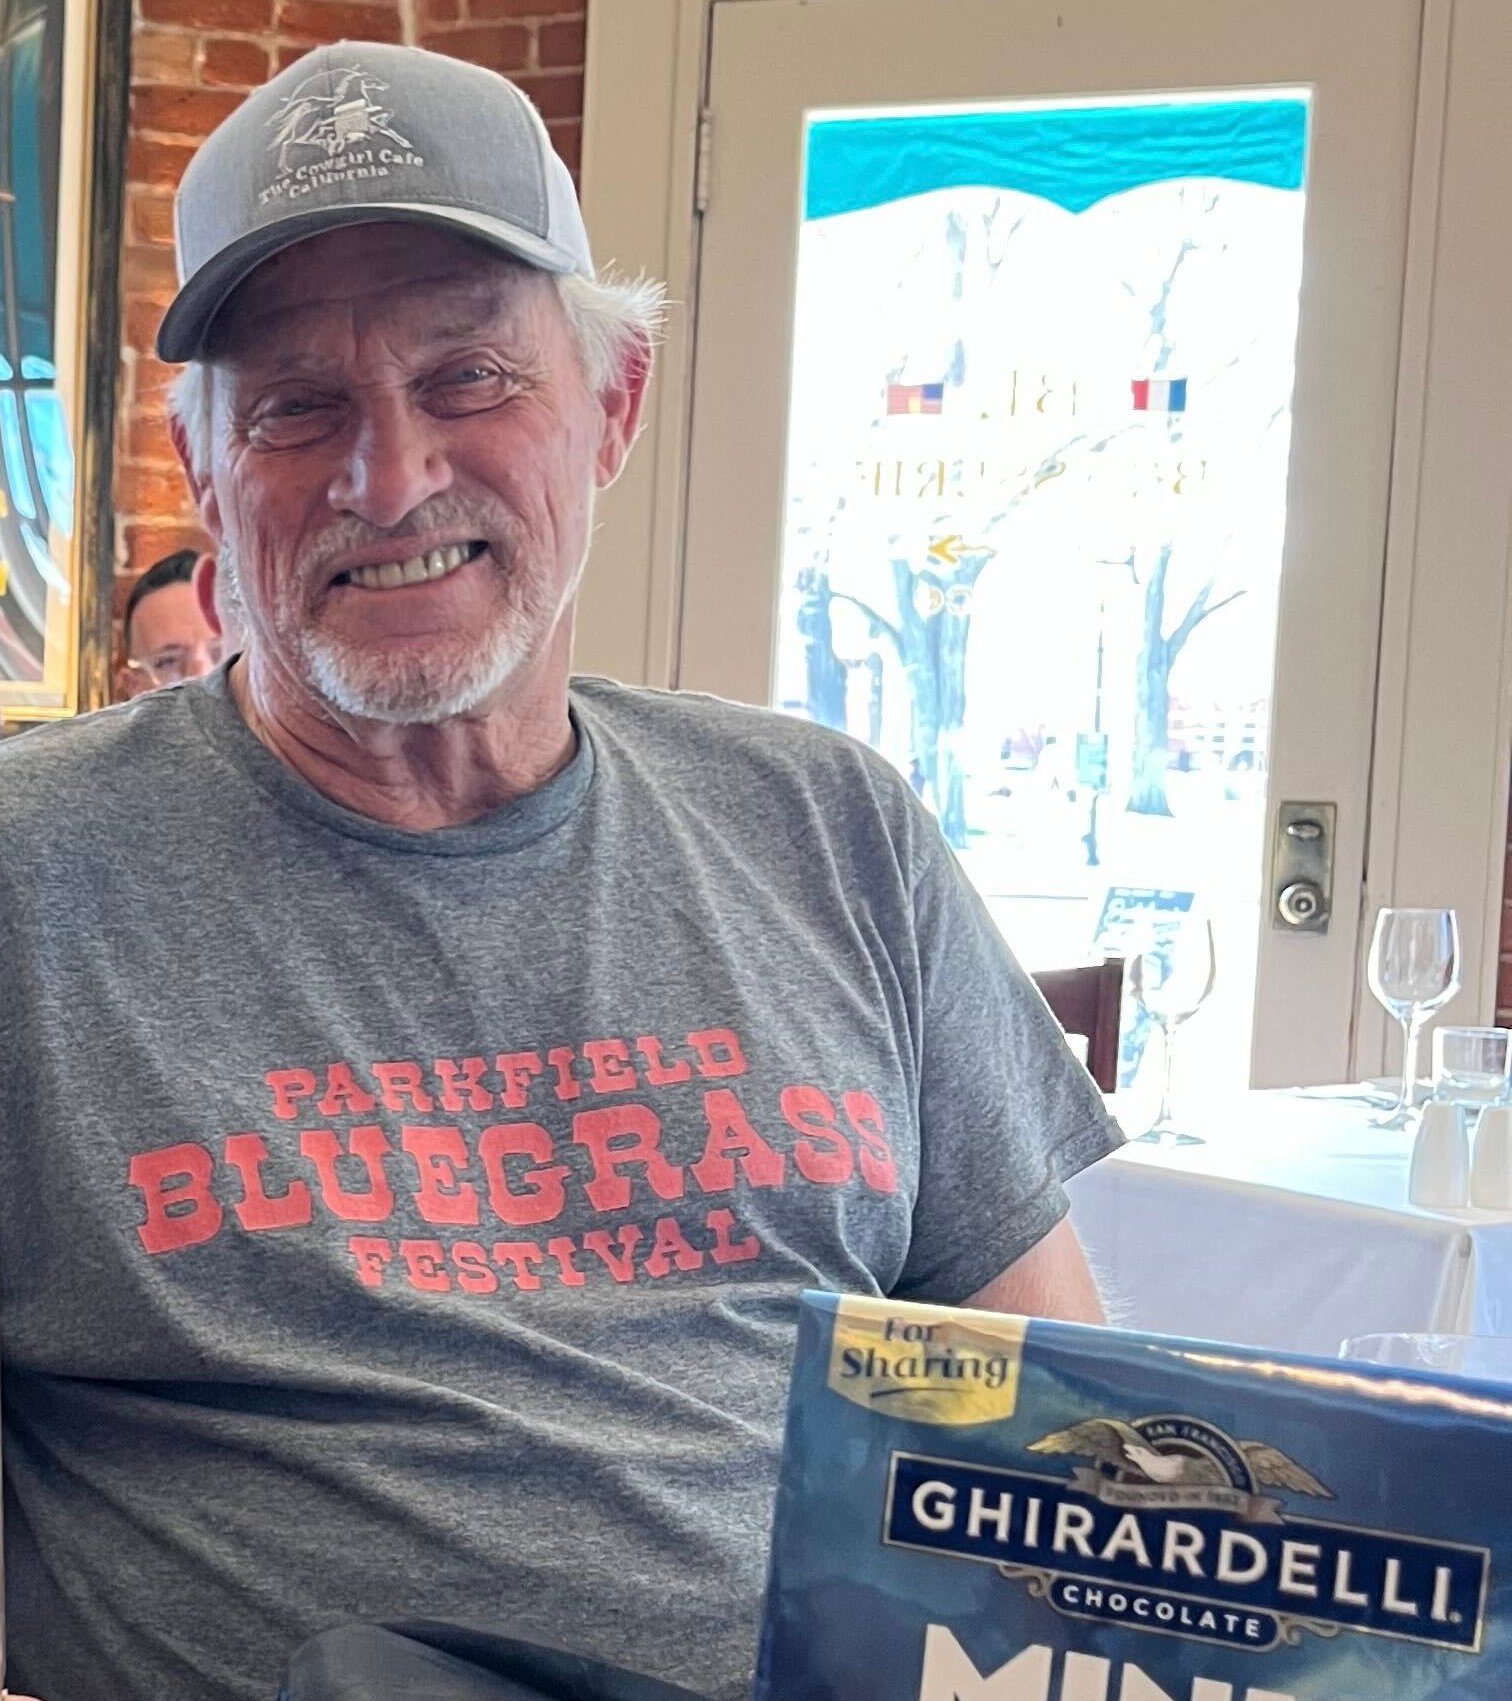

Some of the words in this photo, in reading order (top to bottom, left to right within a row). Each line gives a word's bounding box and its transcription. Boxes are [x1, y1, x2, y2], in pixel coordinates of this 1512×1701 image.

[259, 178, 291, 205] The
[296, 149, 374, 181] Cowgirl
[379, 149, 425, 168] Cafe
[289, 165, 390, 198] California
[265, 1028, 751, 1120] PARKFIELD
[128, 1086, 899, 1255] BLUEGRASS
[349, 1209, 760, 1294] FESTIVAL
[884, 1316, 941, 1343] For
[841, 1346, 1009, 1389] Sharing
[1063, 1585, 1264, 1638] CHOCOLATE
